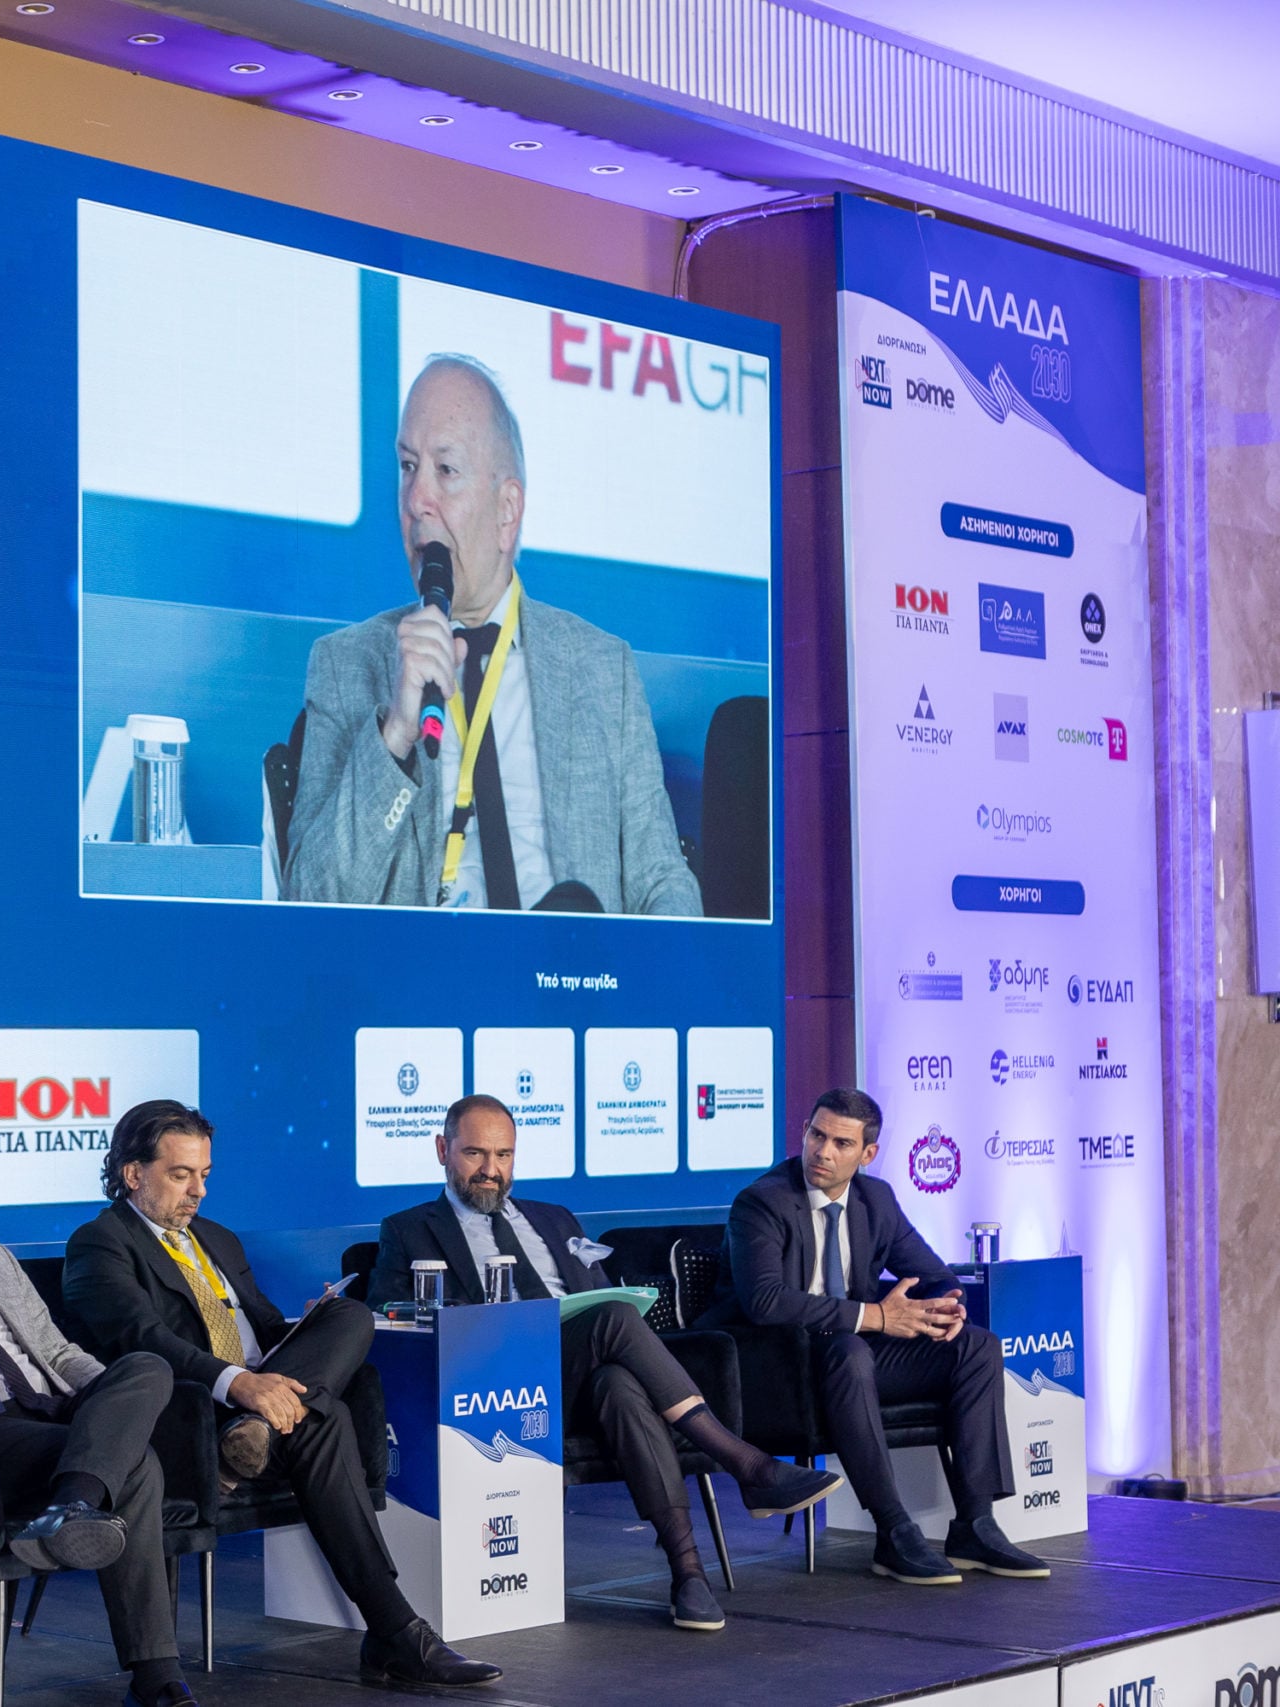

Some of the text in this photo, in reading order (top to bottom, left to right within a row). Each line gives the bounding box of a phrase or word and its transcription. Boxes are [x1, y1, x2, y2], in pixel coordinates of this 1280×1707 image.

[929, 271, 1069, 345] ΕΛΛΑΔΑ
[877, 334, 927, 355] ΔΙΟΡΓΑΝΩΣΗ
[862, 354, 885, 383] NEXT
[1031, 344, 1071, 403] 2030
[864, 386, 889, 405] NOW
[960, 516, 1059, 547] ΑΣΗΜΕΝΙΟΙ ΧΟΡΗΓΟΙ
[896, 615, 950, 635] ΓΙΑ ΠΑΝΤΑ
[1084, 622, 1102, 635] ONEX
[896, 724, 953, 745] VENERGY
[997, 720, 1026, 736] AVAX
[1057, 728, 1104, 747] COSMOTE
[992, 807, 1052, 836] Olympios
[999, 886, 1042, 903] ΧΟΡΗΓΟΙ
[536, 972, 618, 991] Υπό την αιγίδα
[1004, 960, 1049, 992] αδμηε
[1087, 980, 1134, 1003] ΕΥΔΑΠ
[908, 1055, 952, 1079] eren
[1012, 1070, 1037, 1080] ENERGY
[1079, 1064, 1128, 1080] ΝΙΤΣΙΑΚΟΣ
[914, 1082, 946, 1091] ΕΛΛΑΣ
[35, 1129, 111, 1152] ΠΑΝΤΑ
[1006, 1139, 1055, 1157] ΤΕΙΡΕΣΙΑΣ
[1002, 1331, 1074, 1358] ΕΛΛΑΔΑ
[1053, 1351, 1075, 1378] 2030
[453, 1386, 548, 1417] ΕΛΛΑΔΑ
[521, 1410, 549, 1440] 2030
[1030, 1440, 1048, 1459] NEXT
[1031, 1462, 1051, 1475] NOW
[489, 1515, 513, 1536] NEXT
[491, 1540, 516, 1554] NOW
